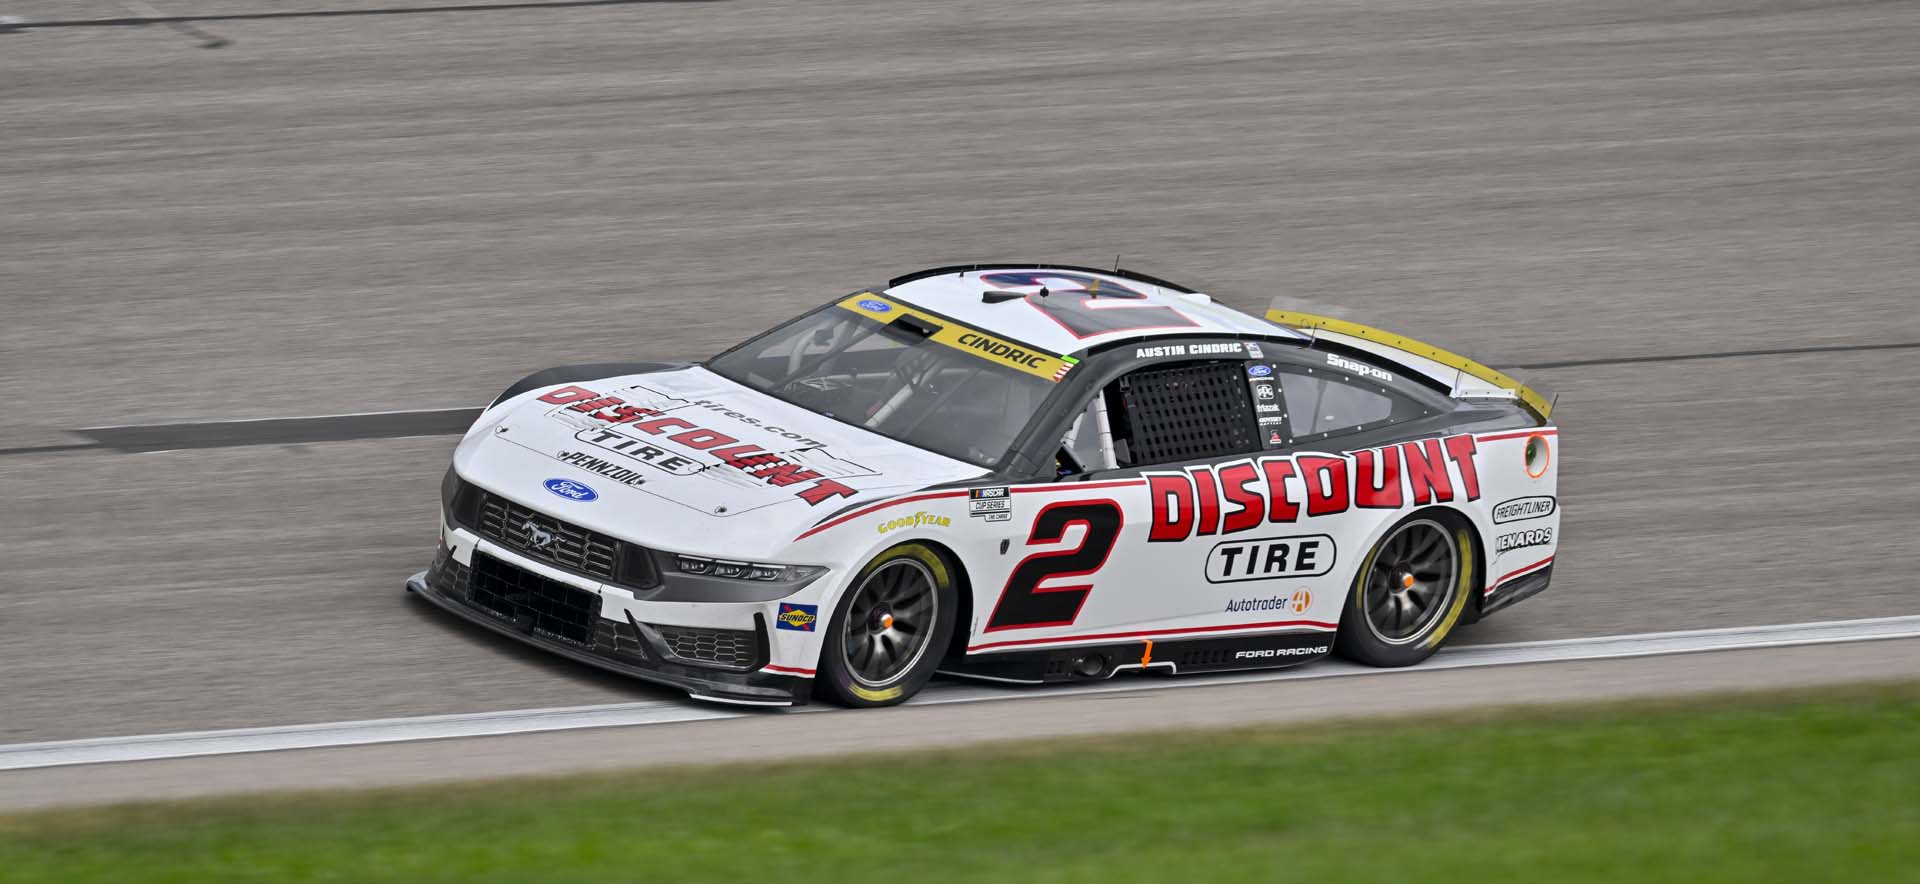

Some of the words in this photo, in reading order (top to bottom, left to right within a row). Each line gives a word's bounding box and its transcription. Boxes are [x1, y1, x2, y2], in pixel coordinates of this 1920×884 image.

[958, 332, 1047, 369] CINDRIC
[1136, 345, 1184, 359] AUSTIN
[1189, 342, 1242, 355] CINDRIC
[1326, 353, 1392, 382] Snap-on
[695, 399, 828, 448] tires.com
[536, 385, 859, 507] DISCOUNT
[591, 430, 693, 471] TIRE
[561, 451, 643, 485] PENNZOIL
[551, 481, 588, 499] Ford
[1147, 434, 1480, 542] DISCOUNT
[975, 501, 986, 510] CUP
[987, 500, 1005, 509] SERIES
[1496, 500, 1551, 519] FREIGHTLINER
[877, 510, 951, 534] GOODYEAR
[983, 498, 1124, 633] 2
[1220, 540, 1321, 577] TIRE
[1225, 595, 1288, 612] Autotrader
[779, 613, 816, 624] SUNOCO
[1235, 650, 1275, 659] FORD
[1276, 646, 1328, 656] RACING
